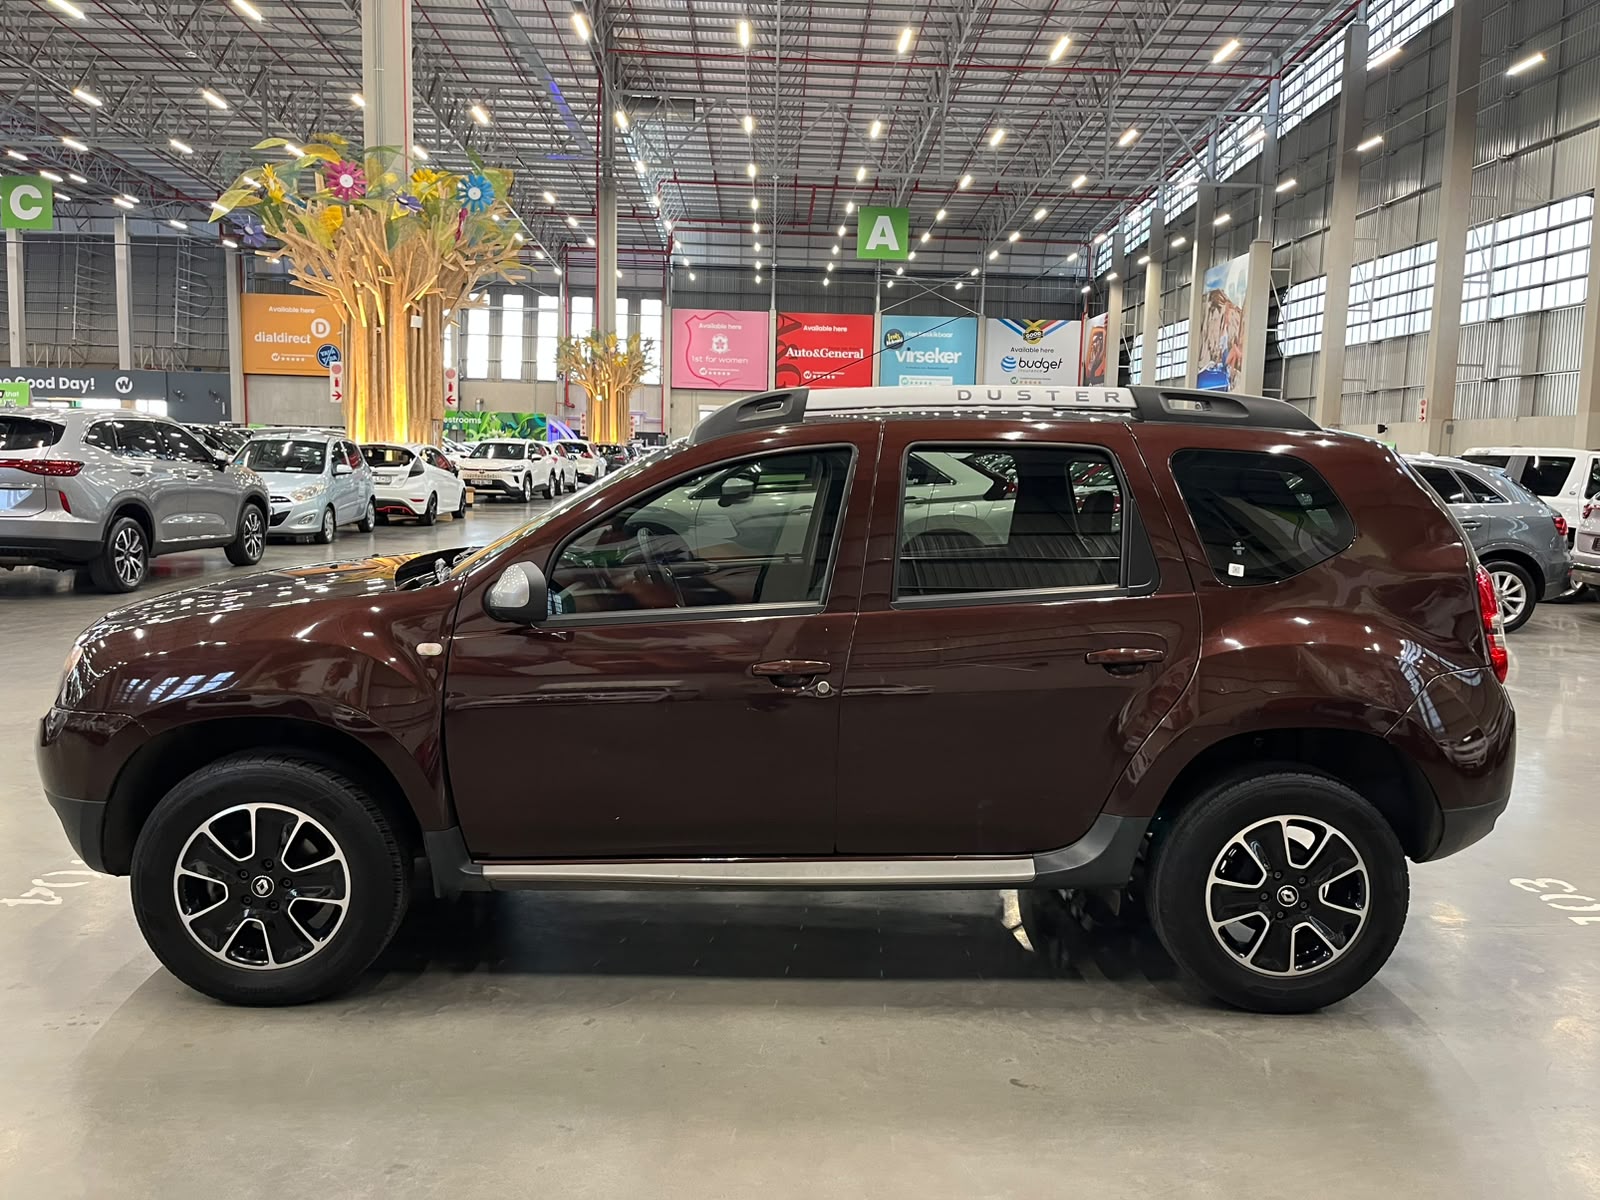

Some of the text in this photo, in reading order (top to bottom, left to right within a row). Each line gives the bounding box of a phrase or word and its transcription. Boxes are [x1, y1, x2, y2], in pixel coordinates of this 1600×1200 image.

[10, 184, 43, 220] C
[865, 216, 900, 250] A
[254, 332, 311, 344] dialdirect
[785, 347, 864, 359] Auto&General
[719, 357, 749, 365] women
[1018, 357, 1063, 373] budget
[58, 377, 95, 394] Day!
[957, 390, 1120, 403] DUSTER
